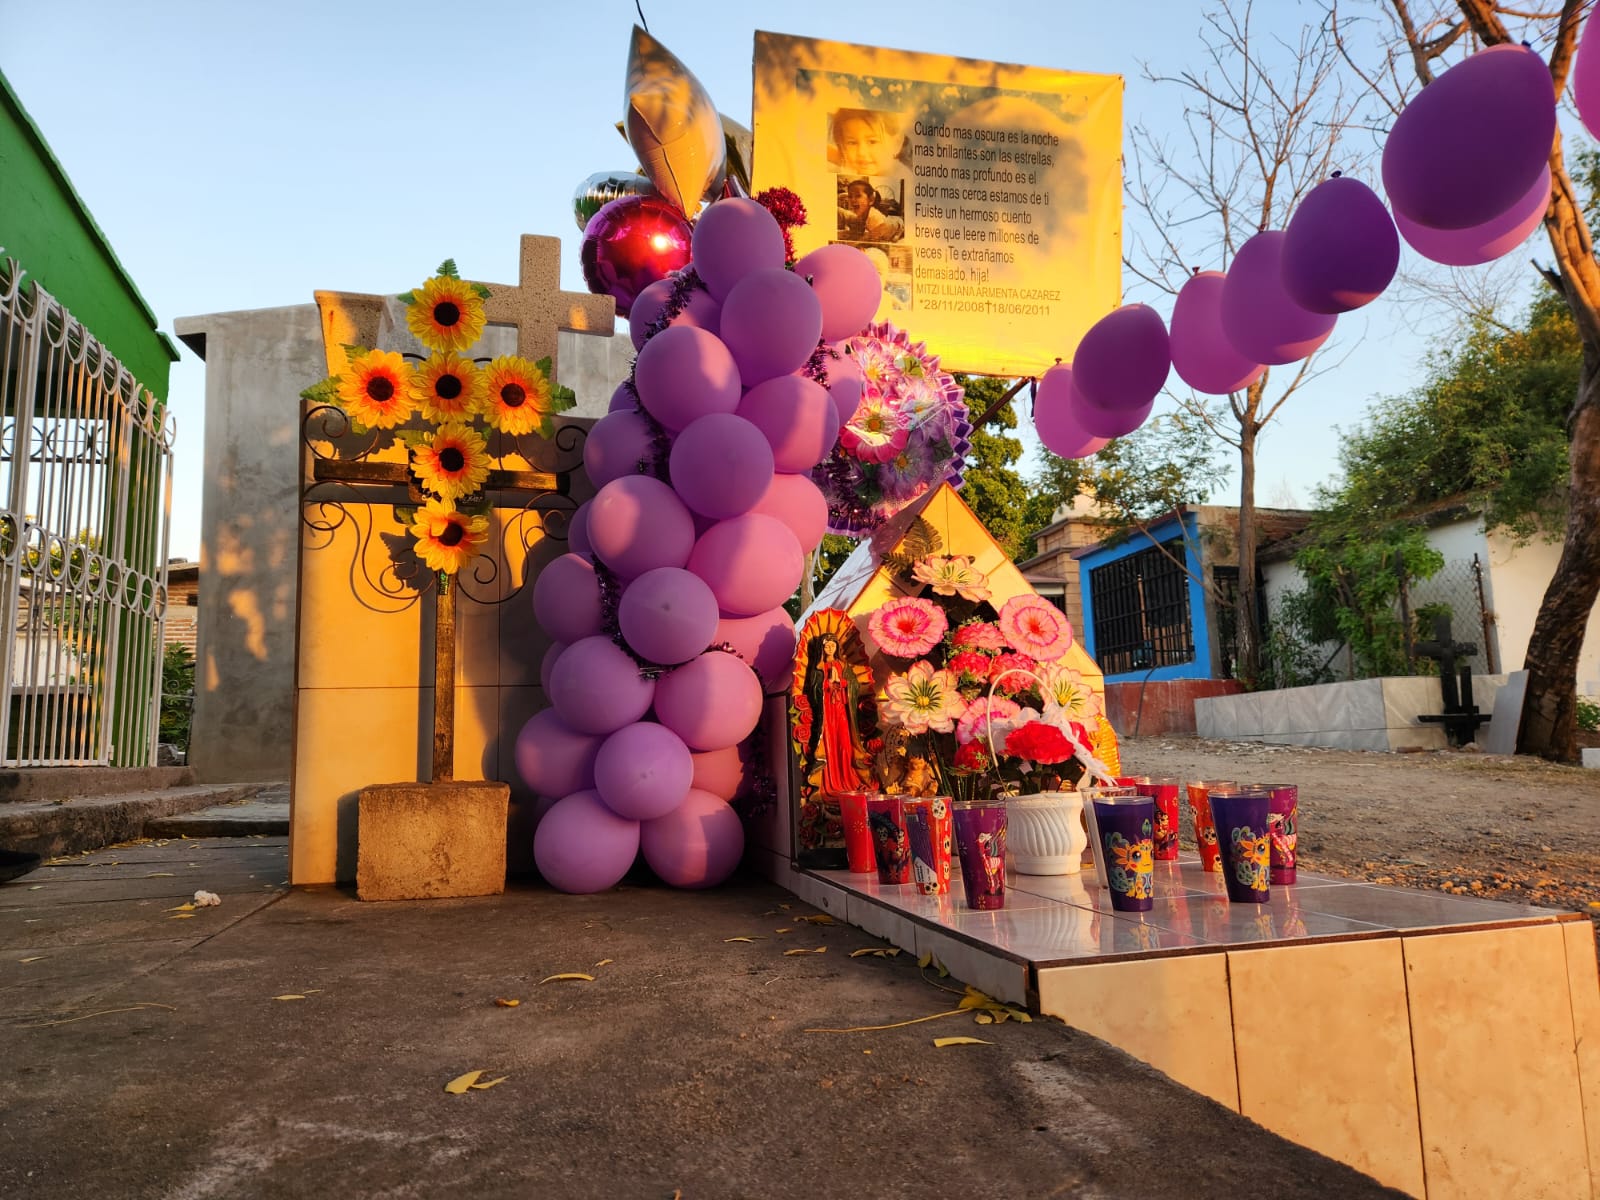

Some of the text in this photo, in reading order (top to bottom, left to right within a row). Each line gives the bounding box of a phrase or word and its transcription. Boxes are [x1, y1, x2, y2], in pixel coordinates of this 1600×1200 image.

[914, 121, 1059, 146] Cuando mas oscura es la noche
[914, 144, 1054, 168] mas brillantes son las estrellas,
[914, 164, 1036, 184] cuando mas profundo es el
[914, 184, 1049, 205] dolor mas cerca estamos de ti
[915, 203, 1031, 224] Fuiste un hermoso cuento
[915, 224, 1039, 244] breve que leere millones de
[915, 247, 942, 259] veces
[962, 248, 1014, 263] extrañamos
[971, 268, 989, 285] hija!
[916, 284, 1060, 300] MITZI LILIANA ARMENTA CAZAREZ
